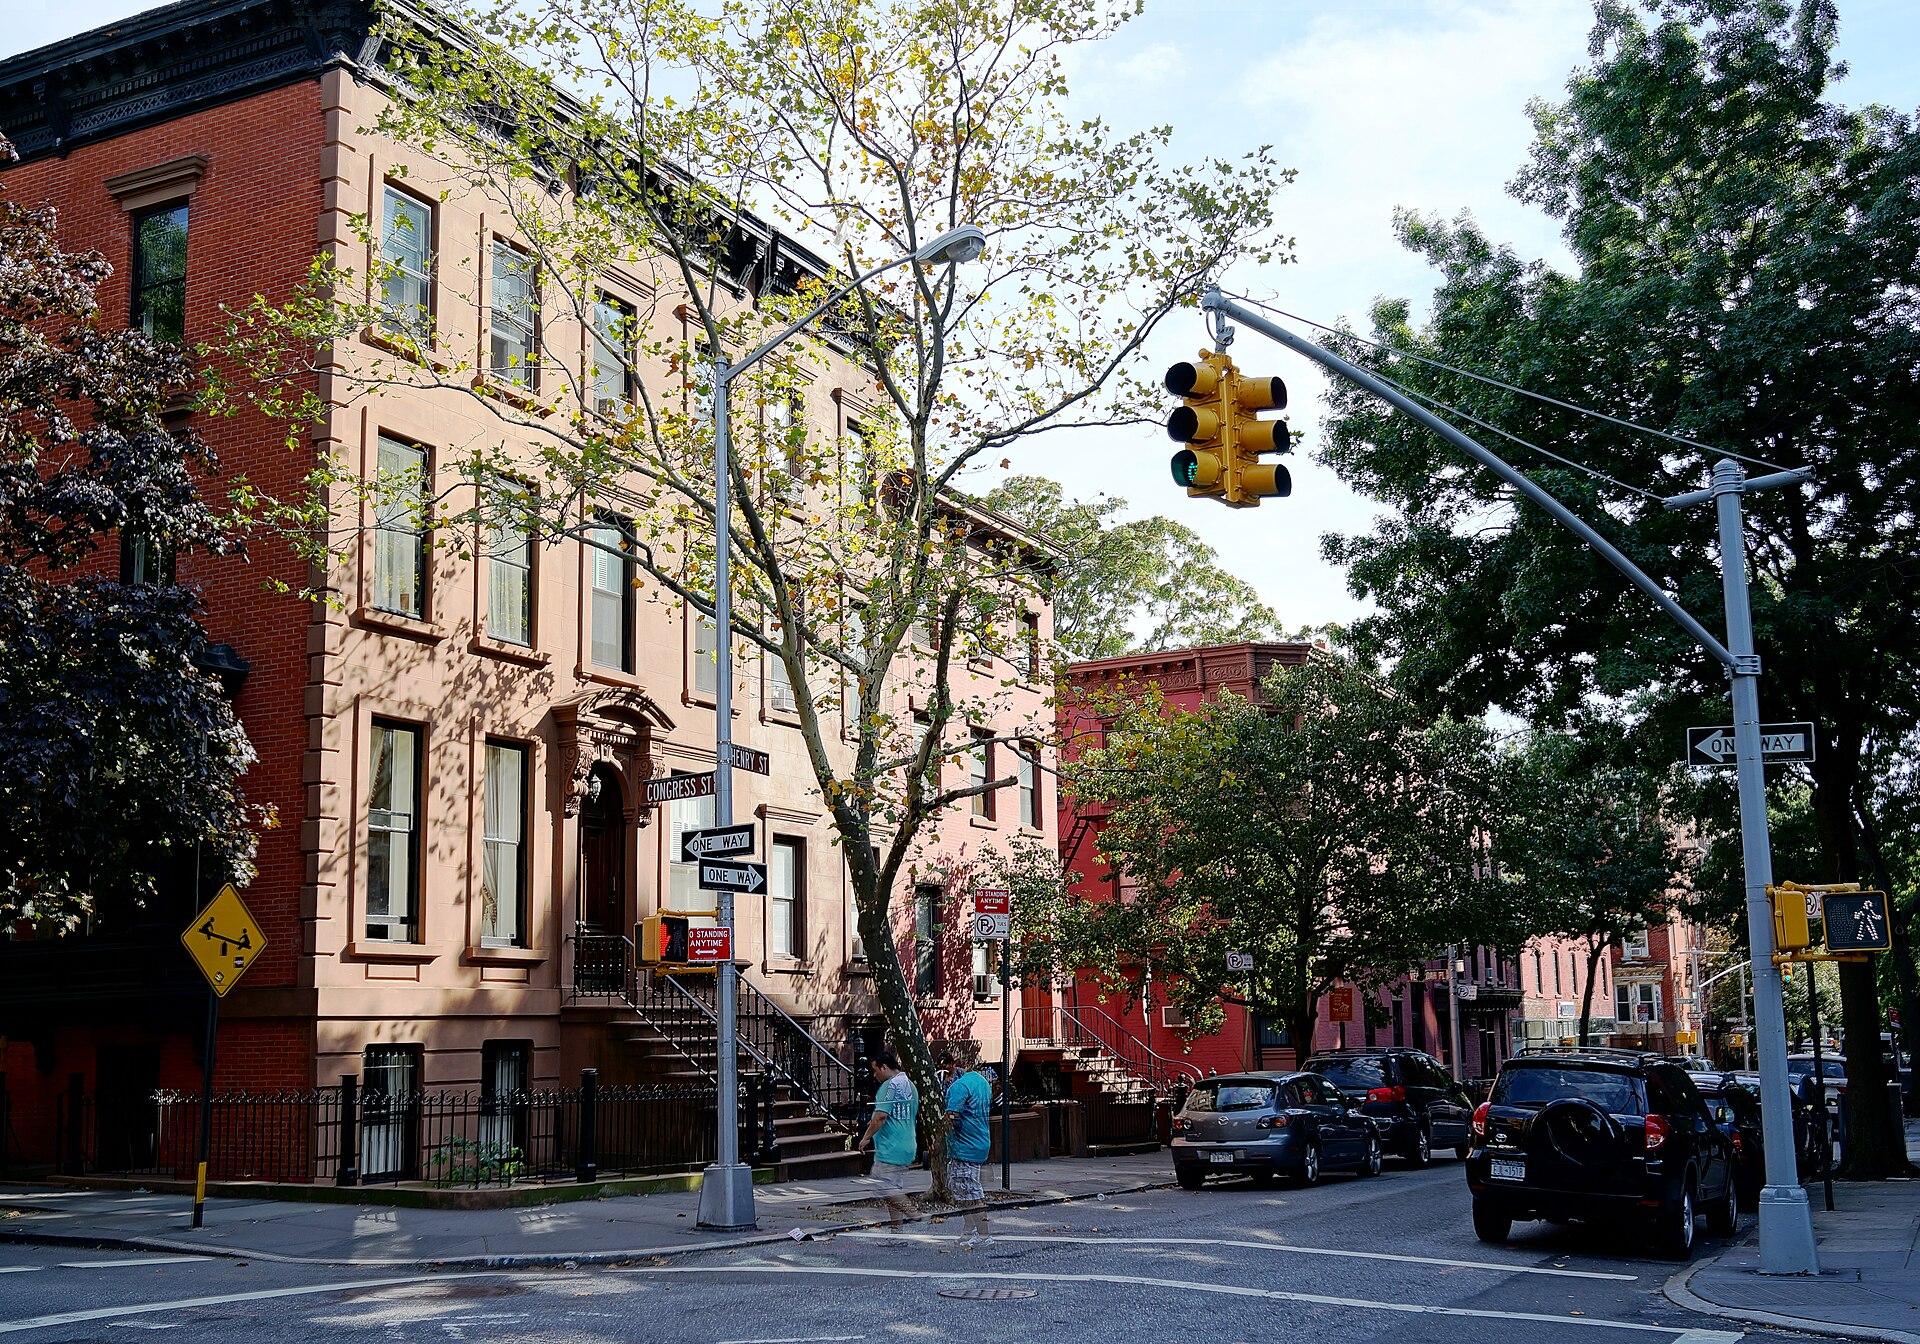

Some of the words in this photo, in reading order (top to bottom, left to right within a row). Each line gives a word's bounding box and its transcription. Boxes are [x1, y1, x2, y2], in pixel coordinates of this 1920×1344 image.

[1711, 738, 1736, 753] ON
[731, 748, 756, 771] HENRY
[758, 755, 768, 774] ST
[646, 777, 697, 802] CONGRESS
[700, 776, 712, 795] ST
[692, 837, 713, 852] ONE
[722, 834, 745, 849] WAY
[708, 868, 729, 883] ONE
[737, 871, 758, 885] WAY
[985, 890, 1008, 898] STANDING
[696, 929, 728, 939] STANDING
[689, 939, 723, 948] ANYTIME
